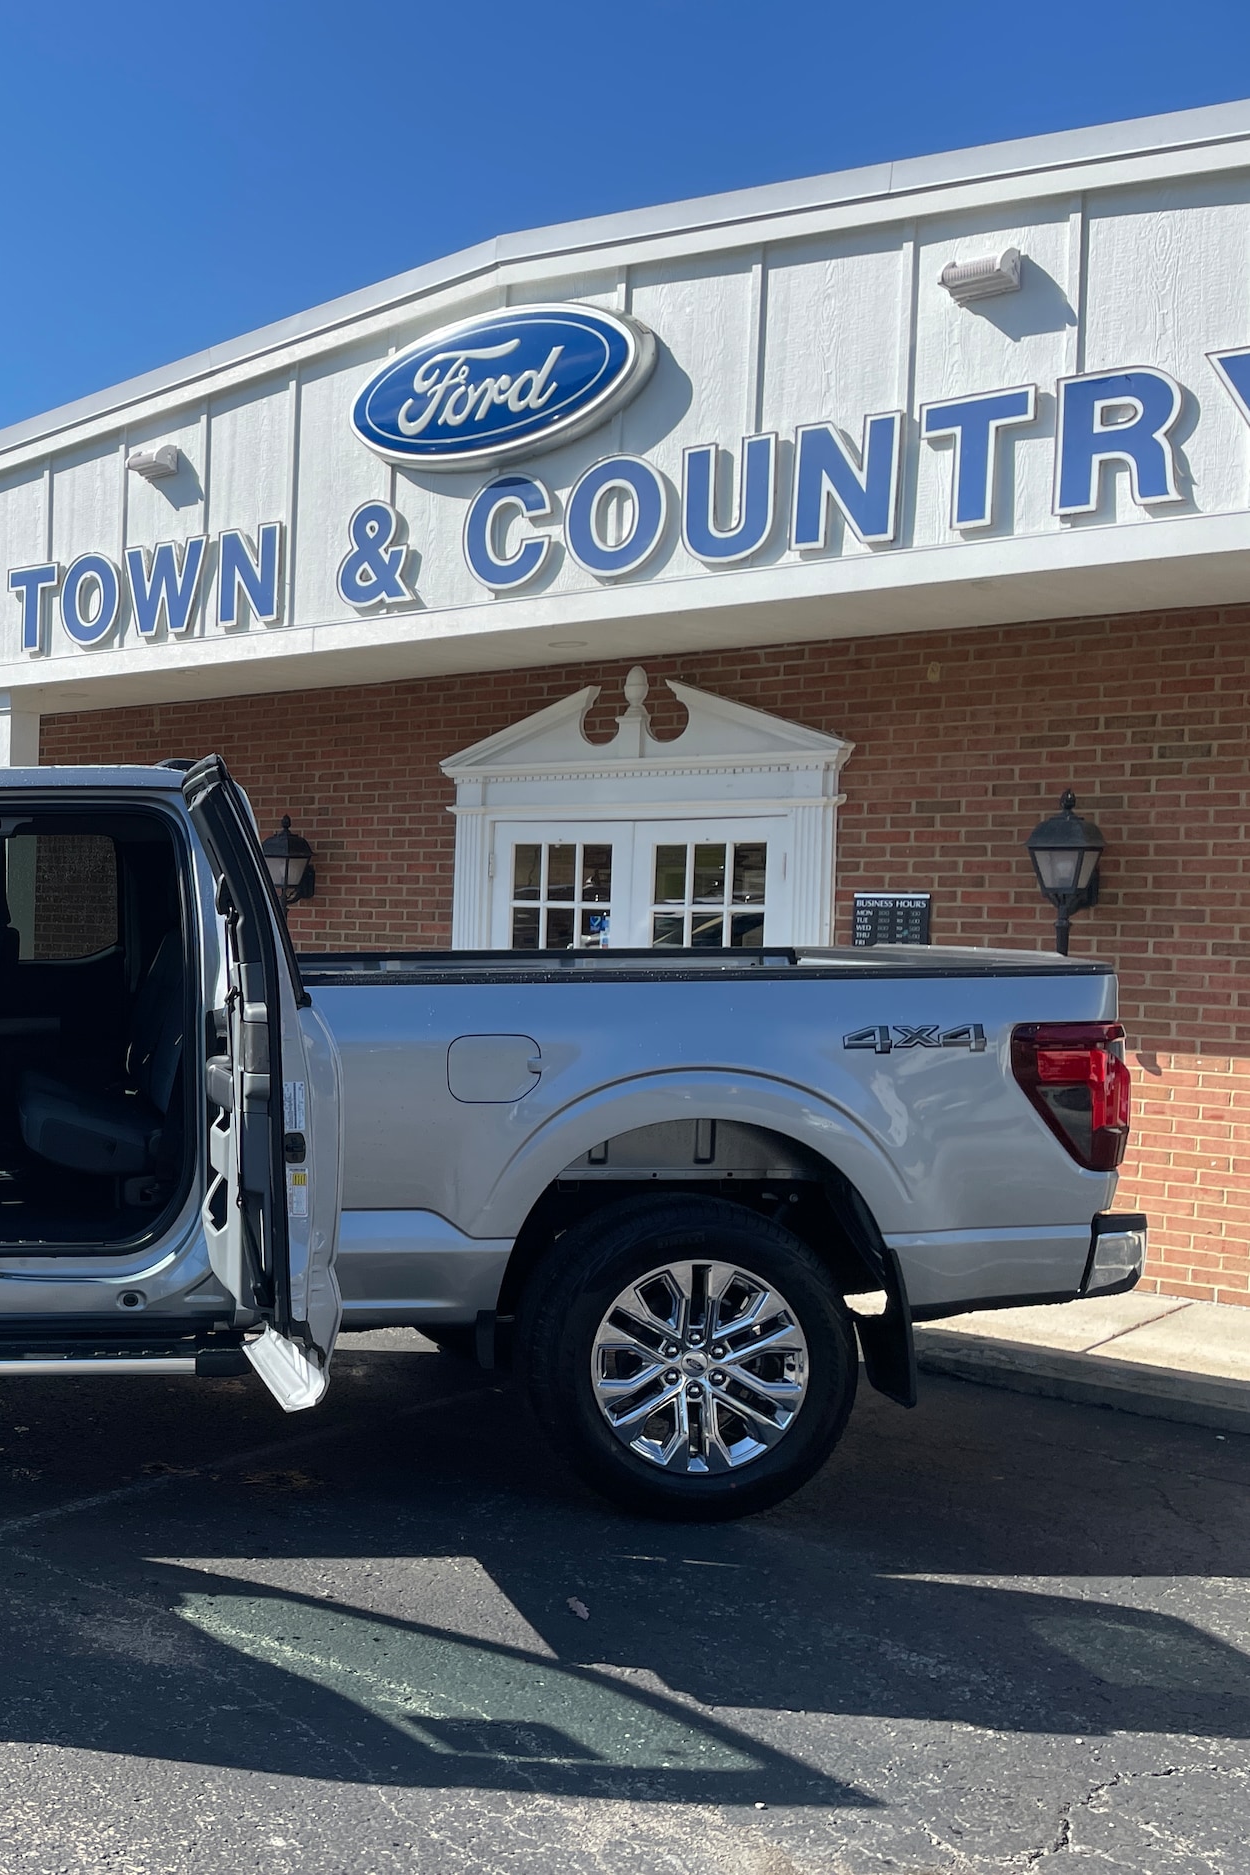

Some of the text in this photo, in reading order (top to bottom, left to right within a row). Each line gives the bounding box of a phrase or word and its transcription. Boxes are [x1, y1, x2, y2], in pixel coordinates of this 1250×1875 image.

[398, 339, 563, 435] Ford
[8, 521, 282, 654] TOWN
[337, 500, 413, 608] &
[856, 900, 926, 908] BUSINESS HOURS
